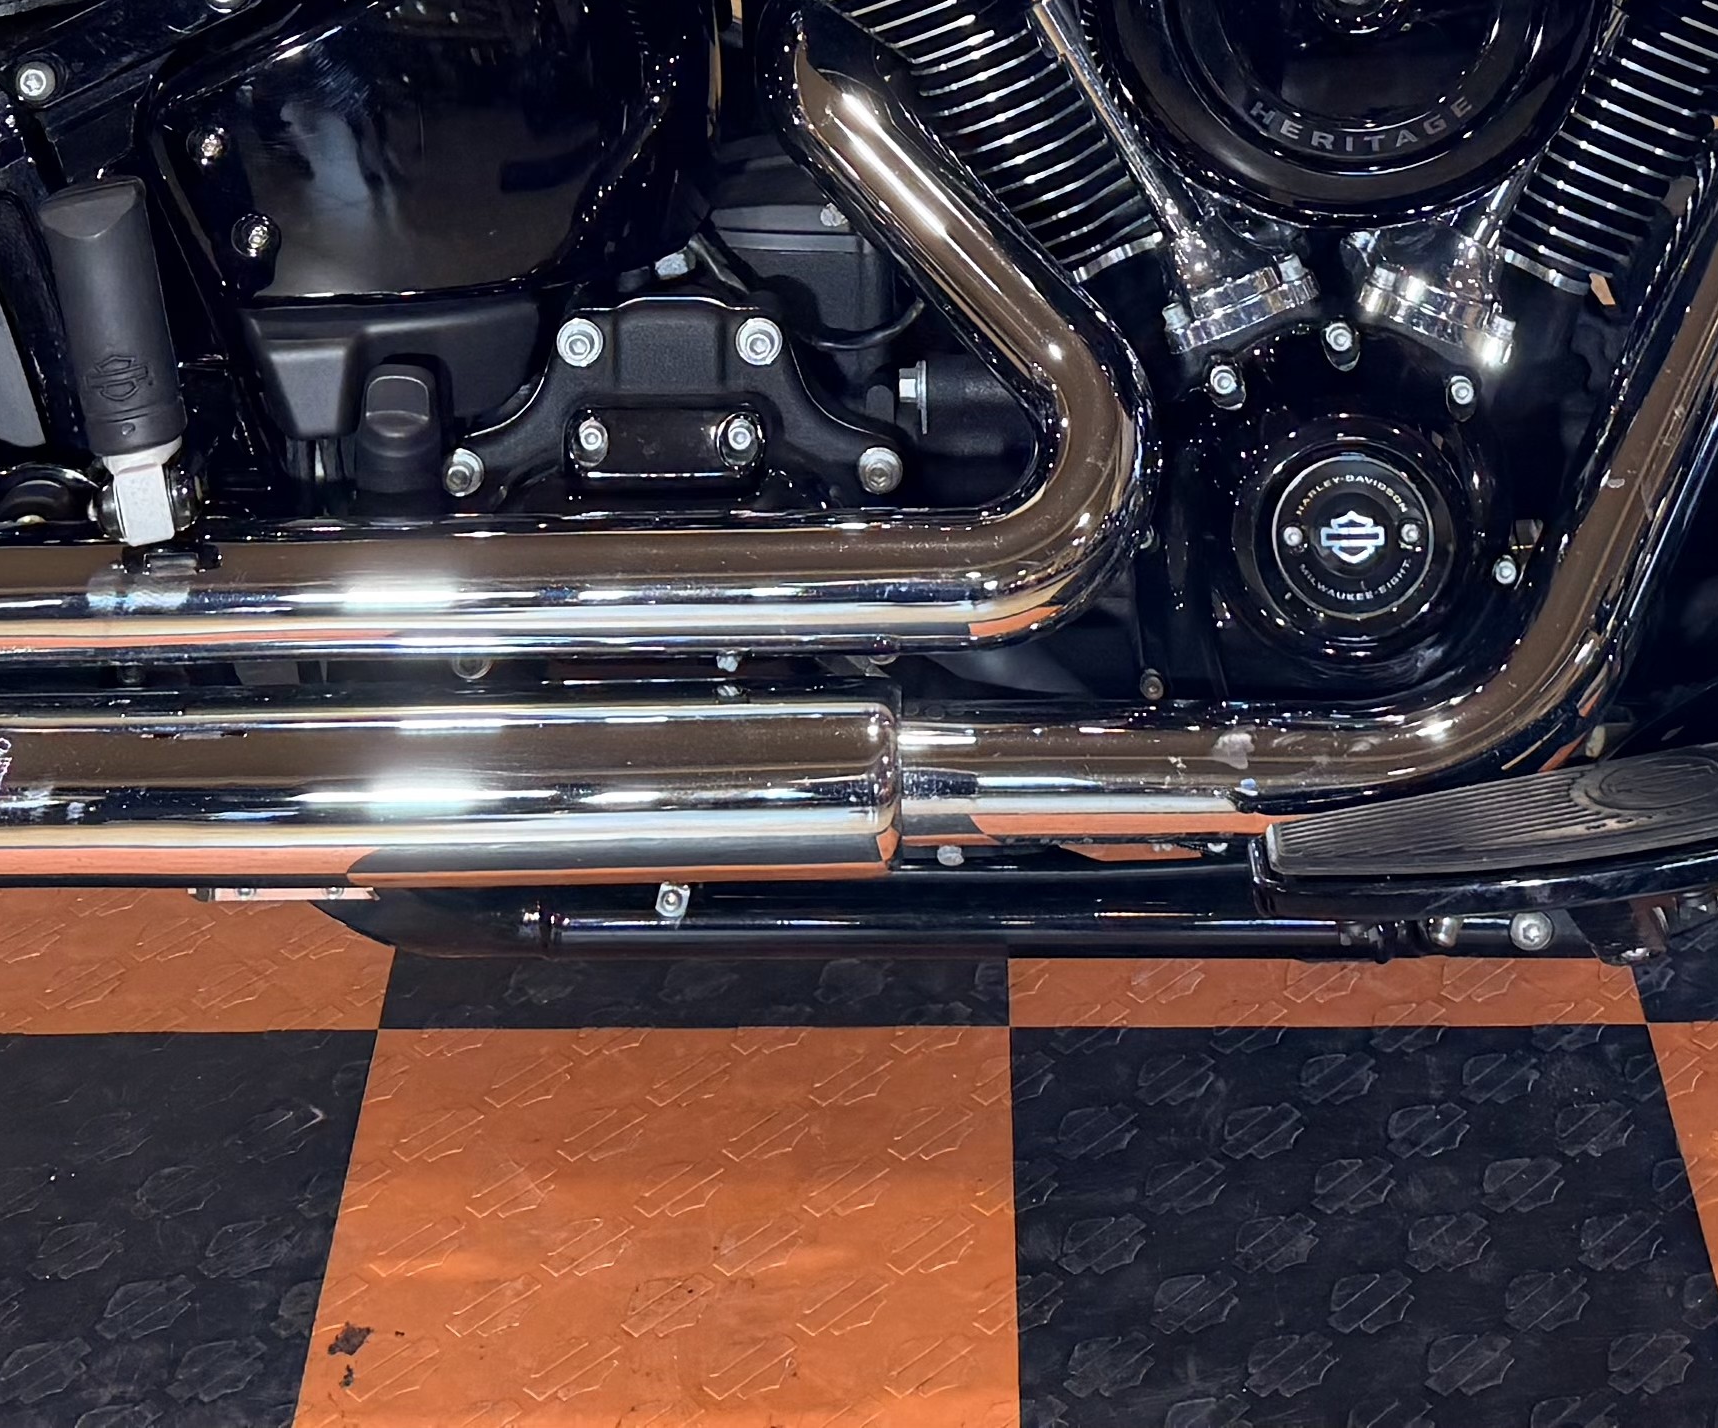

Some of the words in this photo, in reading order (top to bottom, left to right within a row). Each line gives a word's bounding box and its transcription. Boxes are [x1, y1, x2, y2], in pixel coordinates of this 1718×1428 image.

[1249, 96, 1475, 154] HERITAGE
[1296, 475, 1408, 515] HARLEY-DAVIDSON
[1299, 560, 1411, 601] MILWAUKEE-EIGHT
